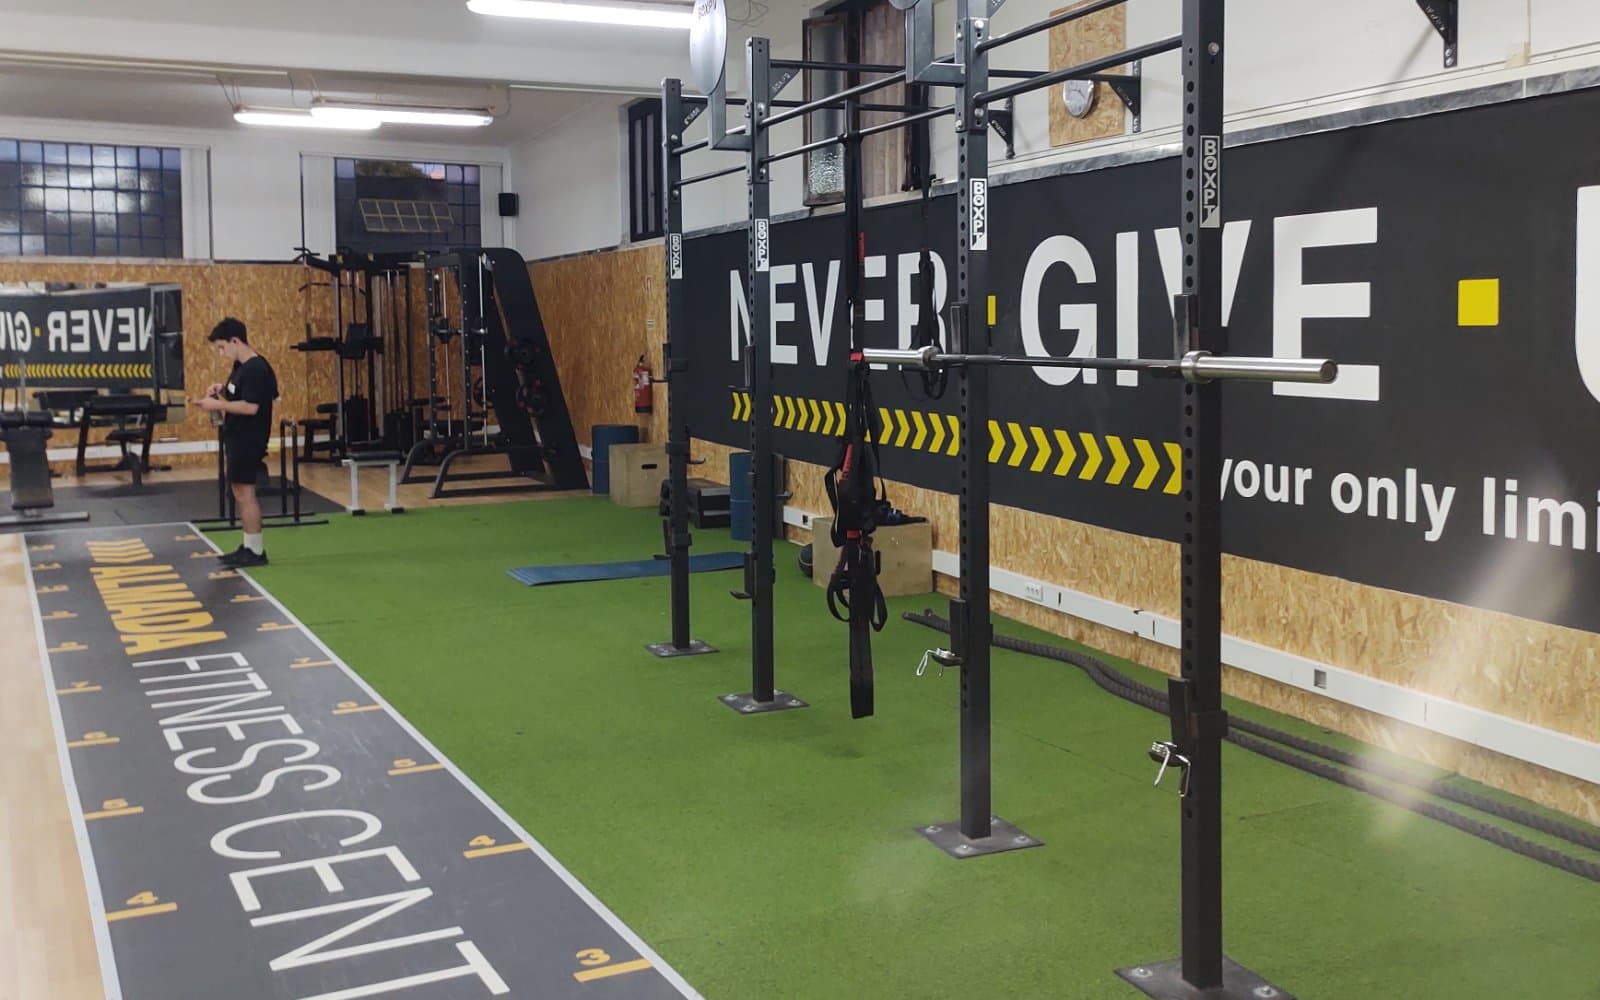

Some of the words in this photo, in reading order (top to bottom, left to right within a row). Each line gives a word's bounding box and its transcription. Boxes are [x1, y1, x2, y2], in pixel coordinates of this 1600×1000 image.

[972, 181, 985, 246] BOXPT
[1202, 138, 1218, 223] BOXPT
[1330, 467, 1456, 542] only
[1482, 477, 1600, 554] lim
[90, 565, 227, 655] ALMADA
[132, 652, 341, 804] FITNESS
[468, 834, 496, 847] 4
[126, 891, 159, 905] 4
[210, 809, 510, 1000] CENT
[575, 948, 611, 966] 3
